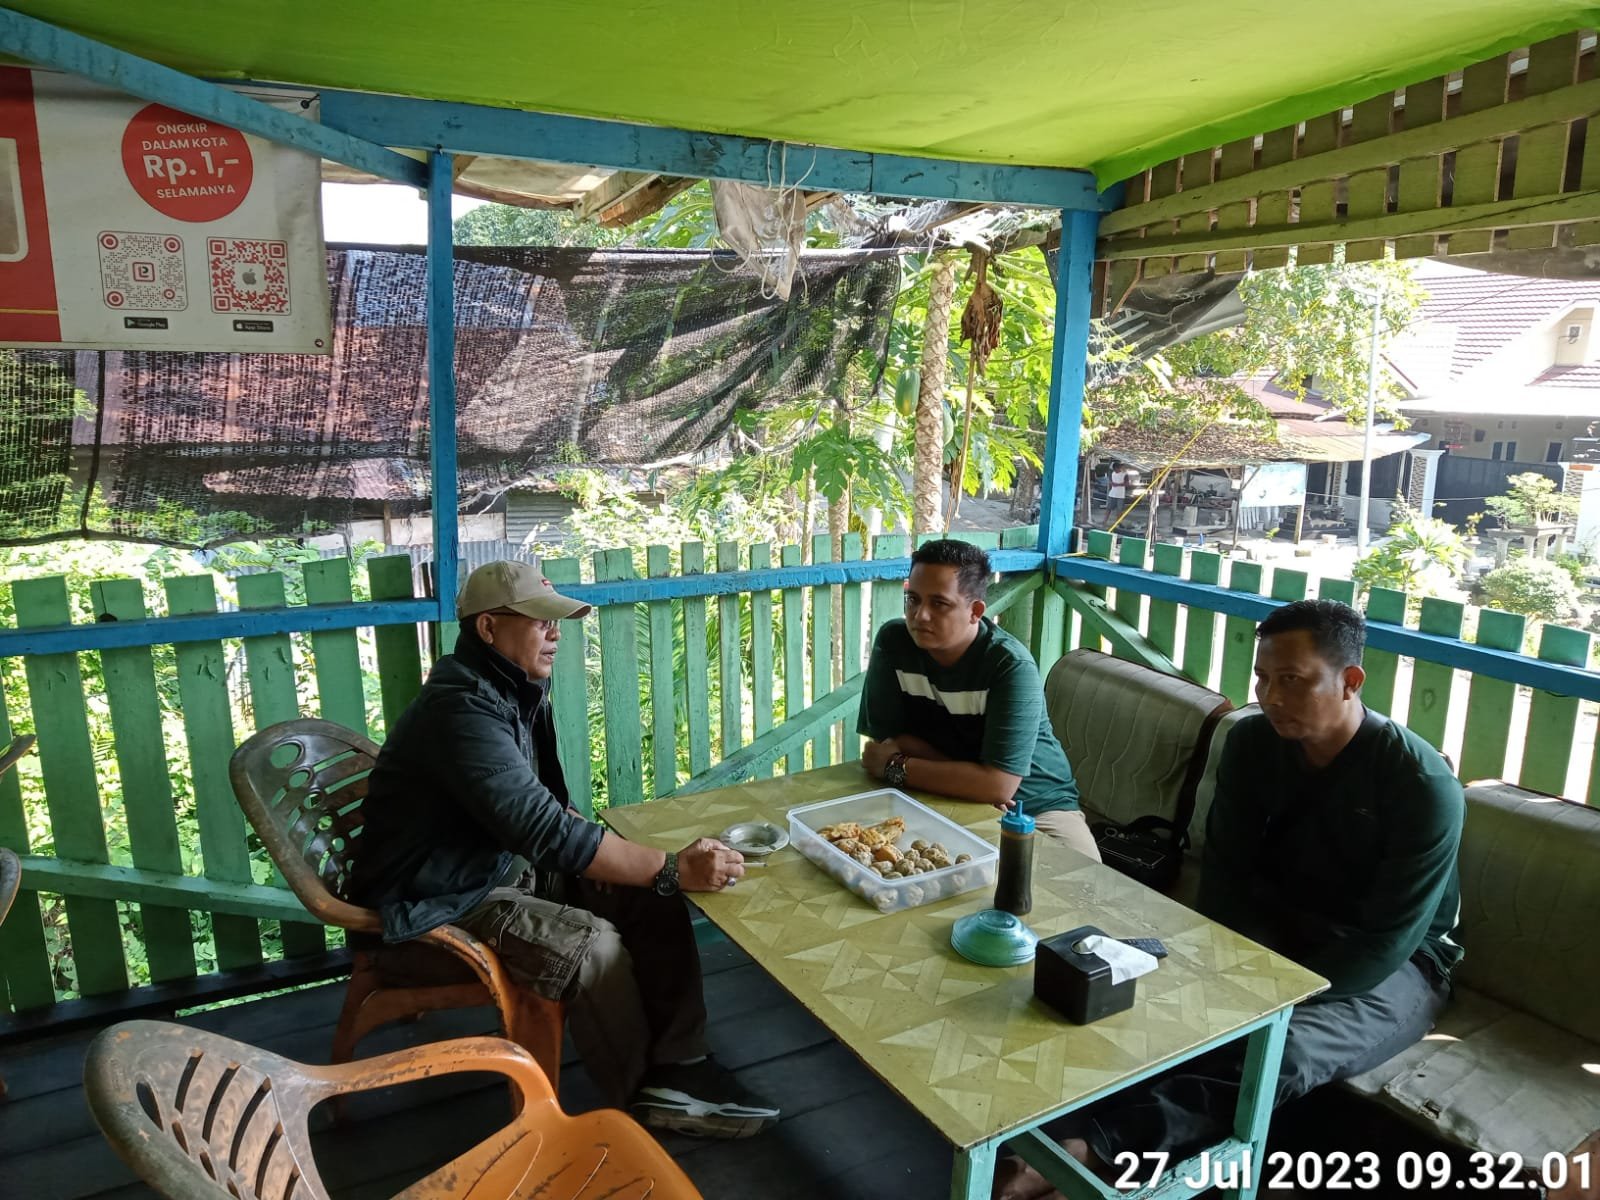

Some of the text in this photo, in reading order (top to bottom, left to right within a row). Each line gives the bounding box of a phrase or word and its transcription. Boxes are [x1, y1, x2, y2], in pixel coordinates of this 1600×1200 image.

[156, 123, 207, 134] ONGKIR
[142, 137, 229, 151] DALAM KOTA
[143, 151, 240, 185] Rp. 1,-
[156, 184, 236, 199] SELAMANYA
